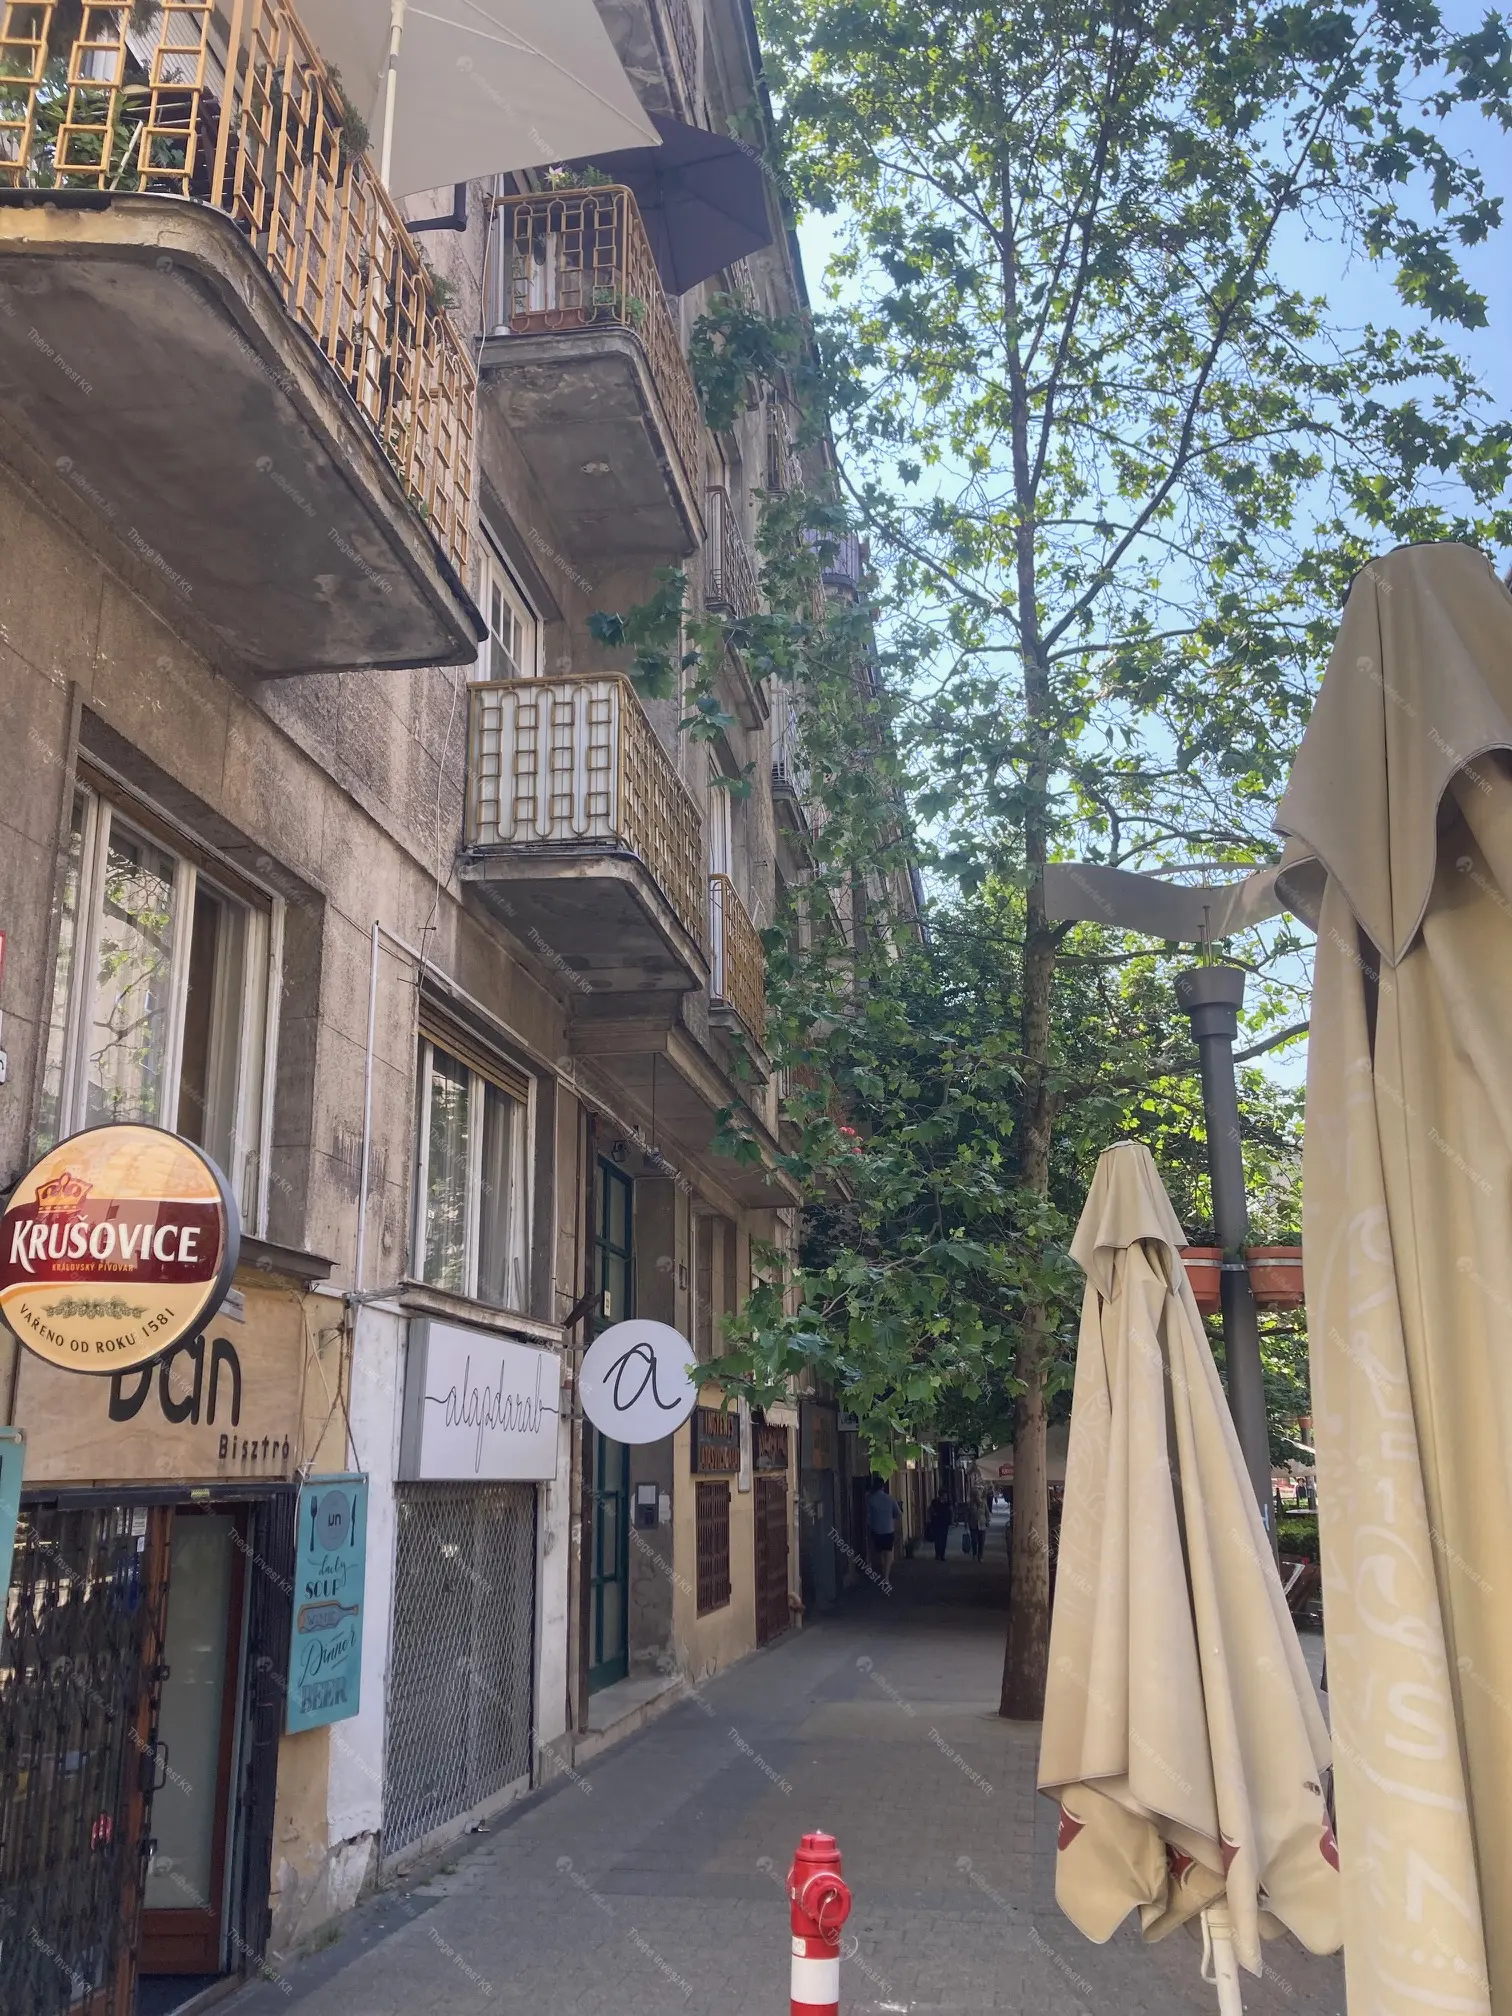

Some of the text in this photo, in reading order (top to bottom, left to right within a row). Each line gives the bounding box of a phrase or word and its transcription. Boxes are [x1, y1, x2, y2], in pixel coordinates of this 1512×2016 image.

[9, 1214, 202, 1274] KRUŠOVICE
[19, 1303, 176, 1354] VAŘENO OD ROKU 1581
[602, 1342, 683, 1412] a
[217, 1432, 290, 1461] Bisztró
[304, 1579, 341, 1600] SOUP
[299, 1676, 348, 1714] BEER
